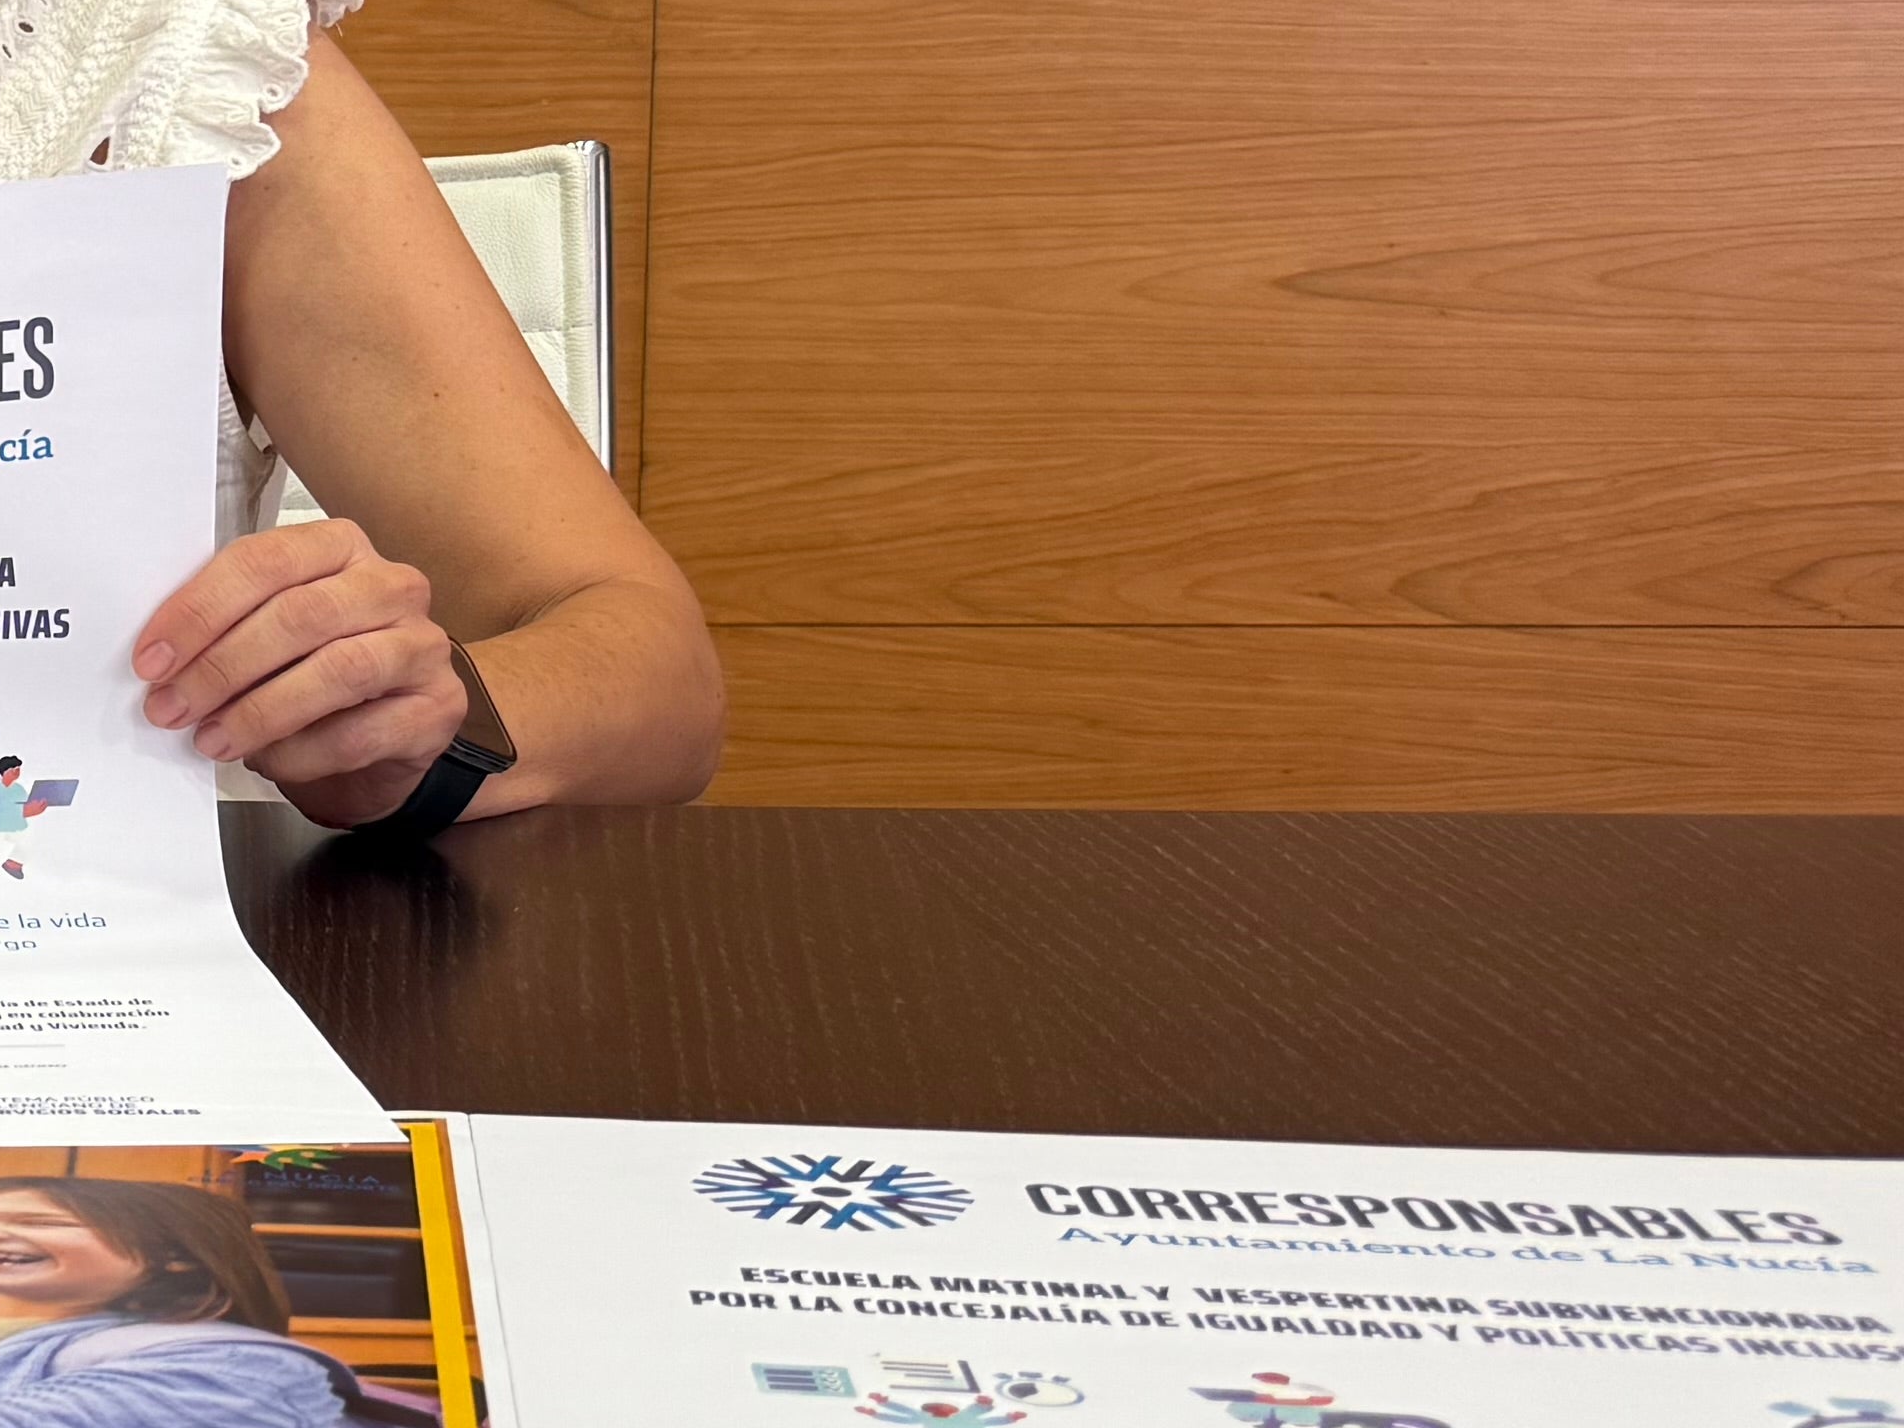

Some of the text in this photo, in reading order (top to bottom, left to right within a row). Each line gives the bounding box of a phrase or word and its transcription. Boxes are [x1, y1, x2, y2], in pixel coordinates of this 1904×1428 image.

[17, 912, 41, 929] la
[49, 911, 106, 928] vida
[1024, 1182, 1843, 1246] CORRESPONSABLES
[1056, 1226, 1877, 1273] Ayuntamiento de La Nucía
[687, 1288, 778, 1310] POR
[787, 1293, 843, 1313] LA
[852, 1296, 1111, 1326] CONCEJALÍA
[1118, 1309, 1180, 1328] DE
[1186, 1311, 1423, 1340] IGUALDAD
[1428, 1322, 1459, 1342] Y
[1473, 1325, 1720, 1353] POLÍTICAS
[739, 1266, 1892, 1333] ESCUELA MATINAL Y VESPERTINA SUBVENCIONADA
